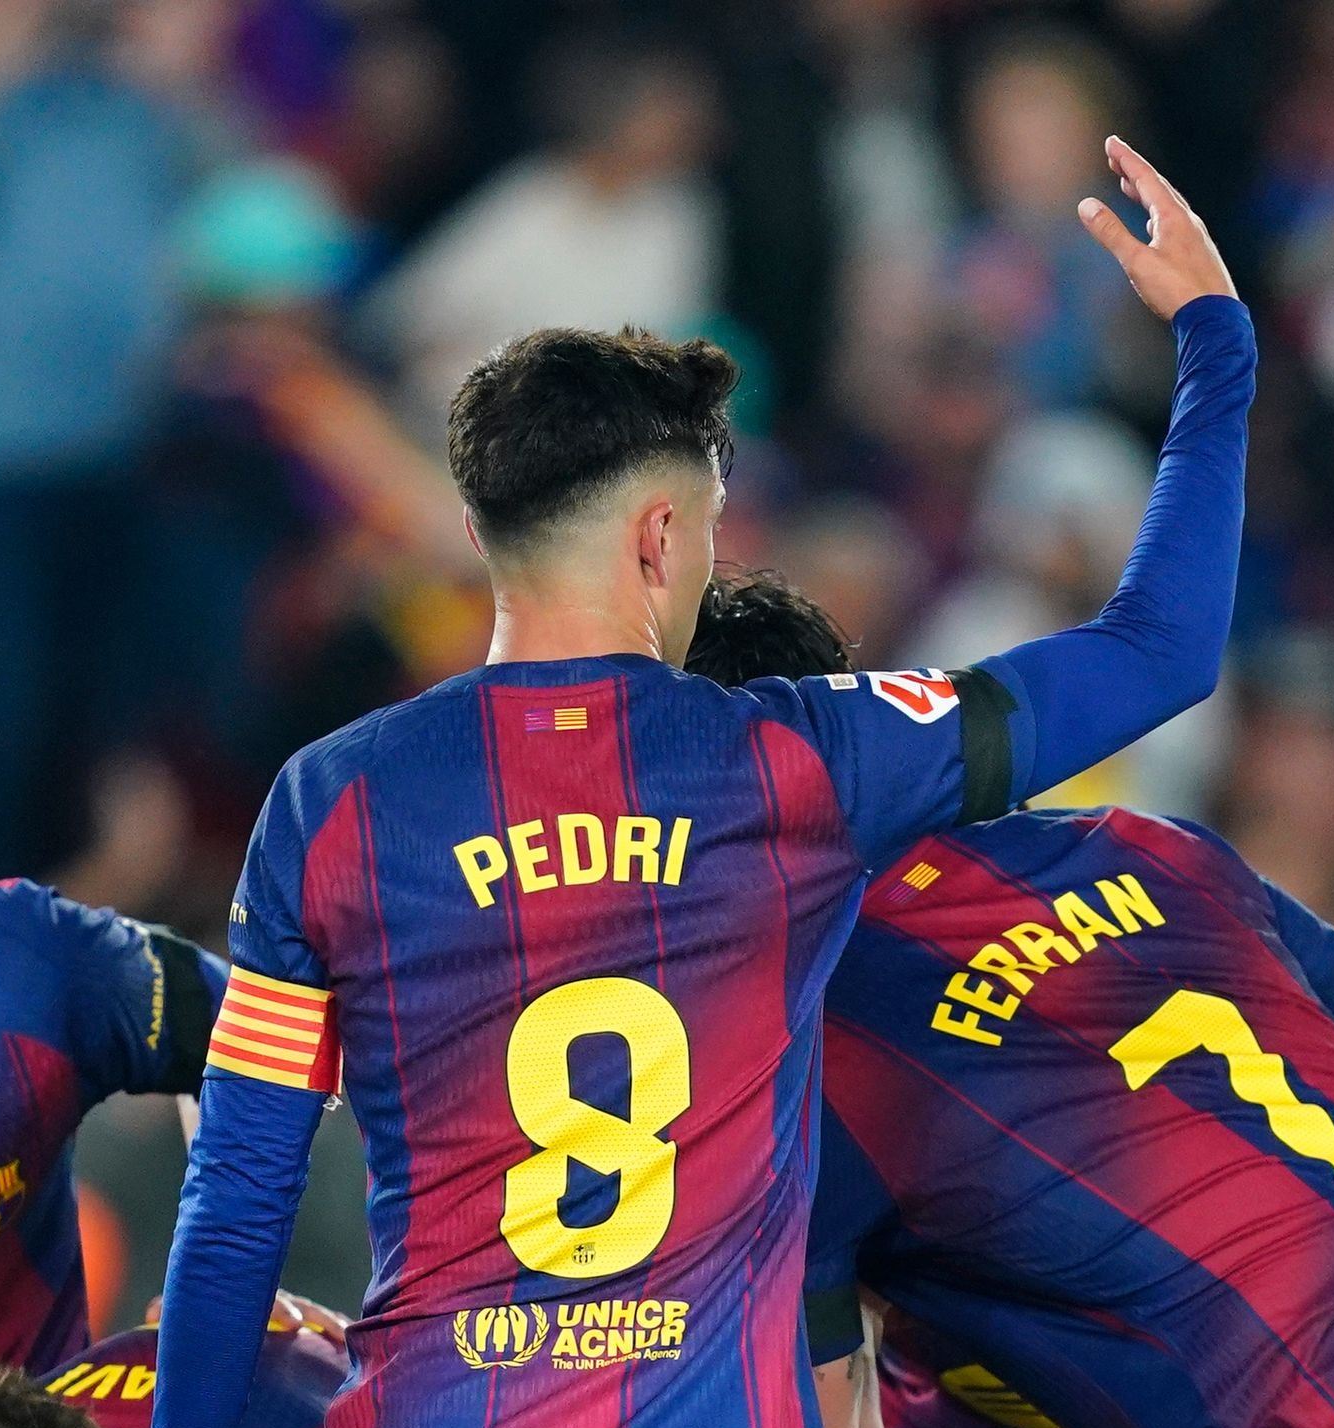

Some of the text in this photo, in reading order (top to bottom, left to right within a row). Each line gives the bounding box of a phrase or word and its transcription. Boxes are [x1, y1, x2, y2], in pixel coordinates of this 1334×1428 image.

[453, 812, 693, 909] PEDRI
[930, 873, 1166, 1047] FERRAN
[499, 976, 691, 1279] 8
[556, 1299, 690, 1329] UNHCR
[551, 1318, 687, 1357] ACNUR
[552, 1358, 574, 1370] The
[576, 1356, 594, 1370] UN
[643, 1348, 681, 1360] Agency
[44, 1362, 157, 1400] AVI
